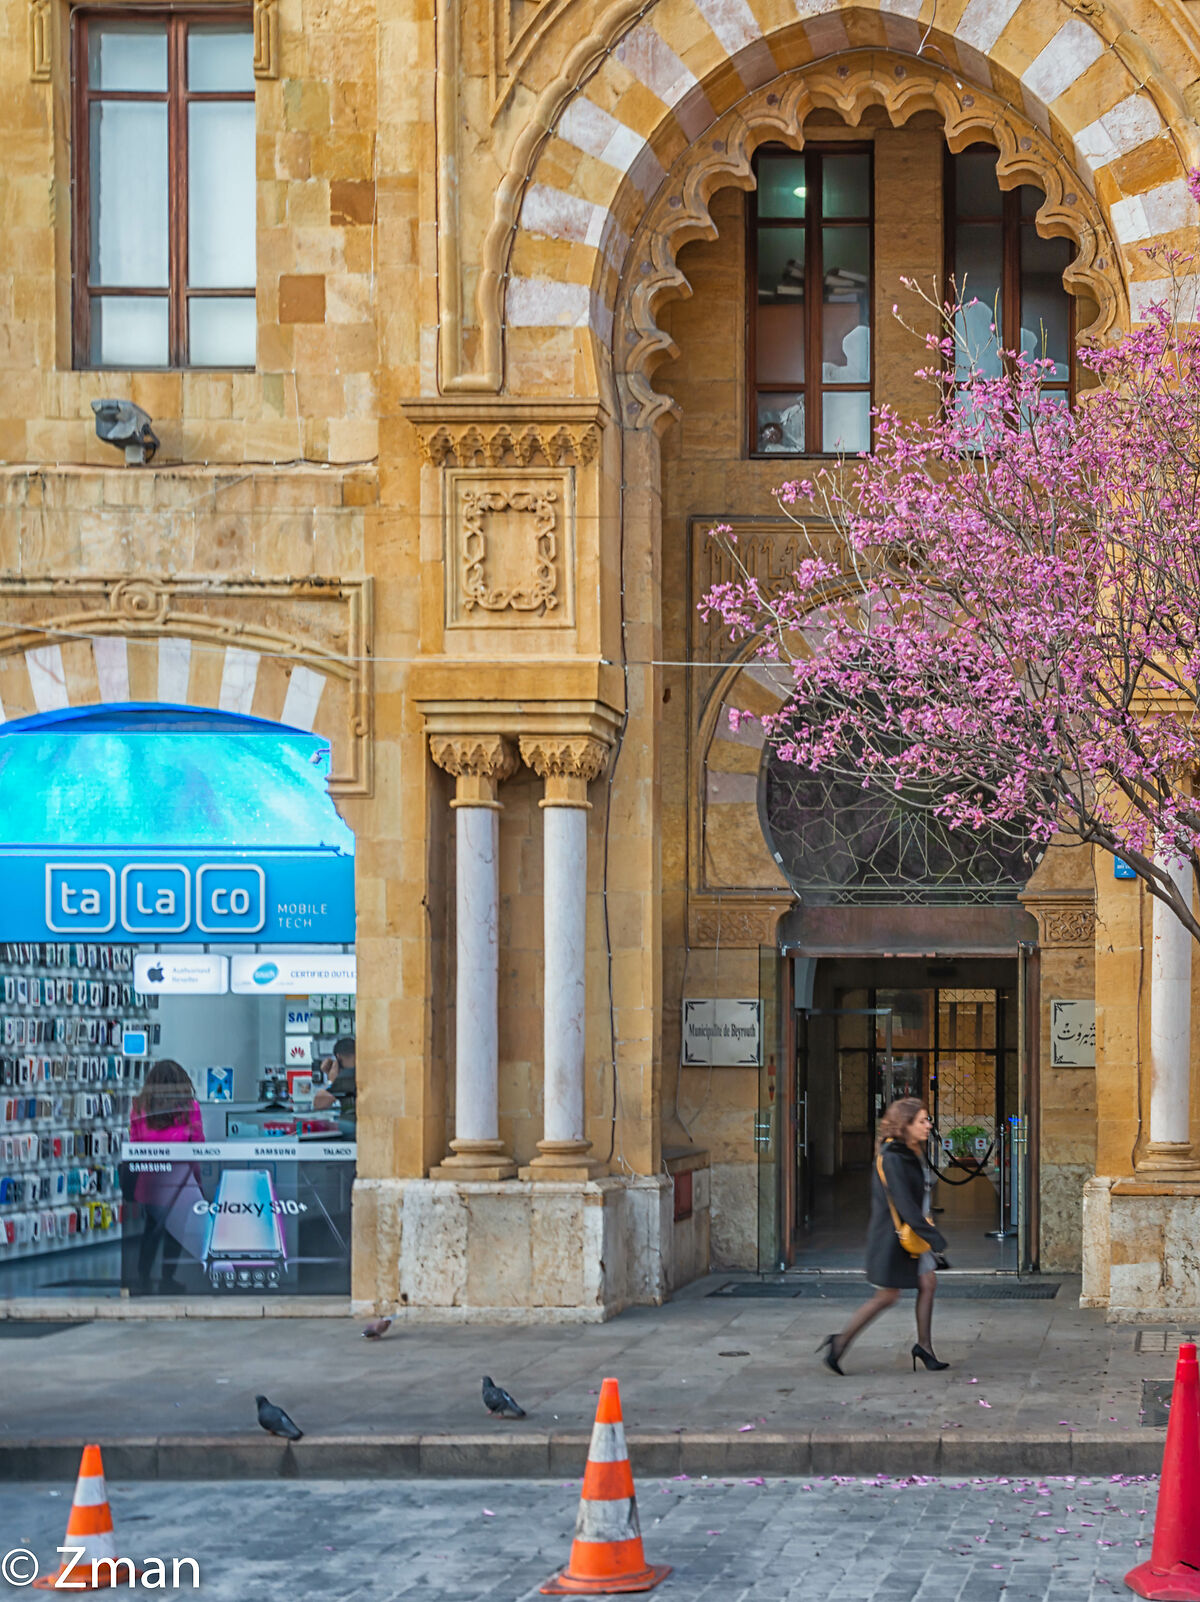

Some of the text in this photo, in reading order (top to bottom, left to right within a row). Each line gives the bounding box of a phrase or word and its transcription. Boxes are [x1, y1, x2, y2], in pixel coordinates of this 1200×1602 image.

[277, 904, 328, 915] MOBILE
[278, 918, 312, 929] TECH
[290, 970, 356, 978] CERTIFIED OUTLE
[723, 1023, 730, 1037] de
[731, 1023, 756, 1040] Beyrouth
[128, 1148, 171, 1156] SAMSUNG
[254, 1148, 296, 1156] SAMSUNG
[128, 1162, 172, 1172] SAMSUNG
[193, 1199, 308, 1218] Galaxy S10+
